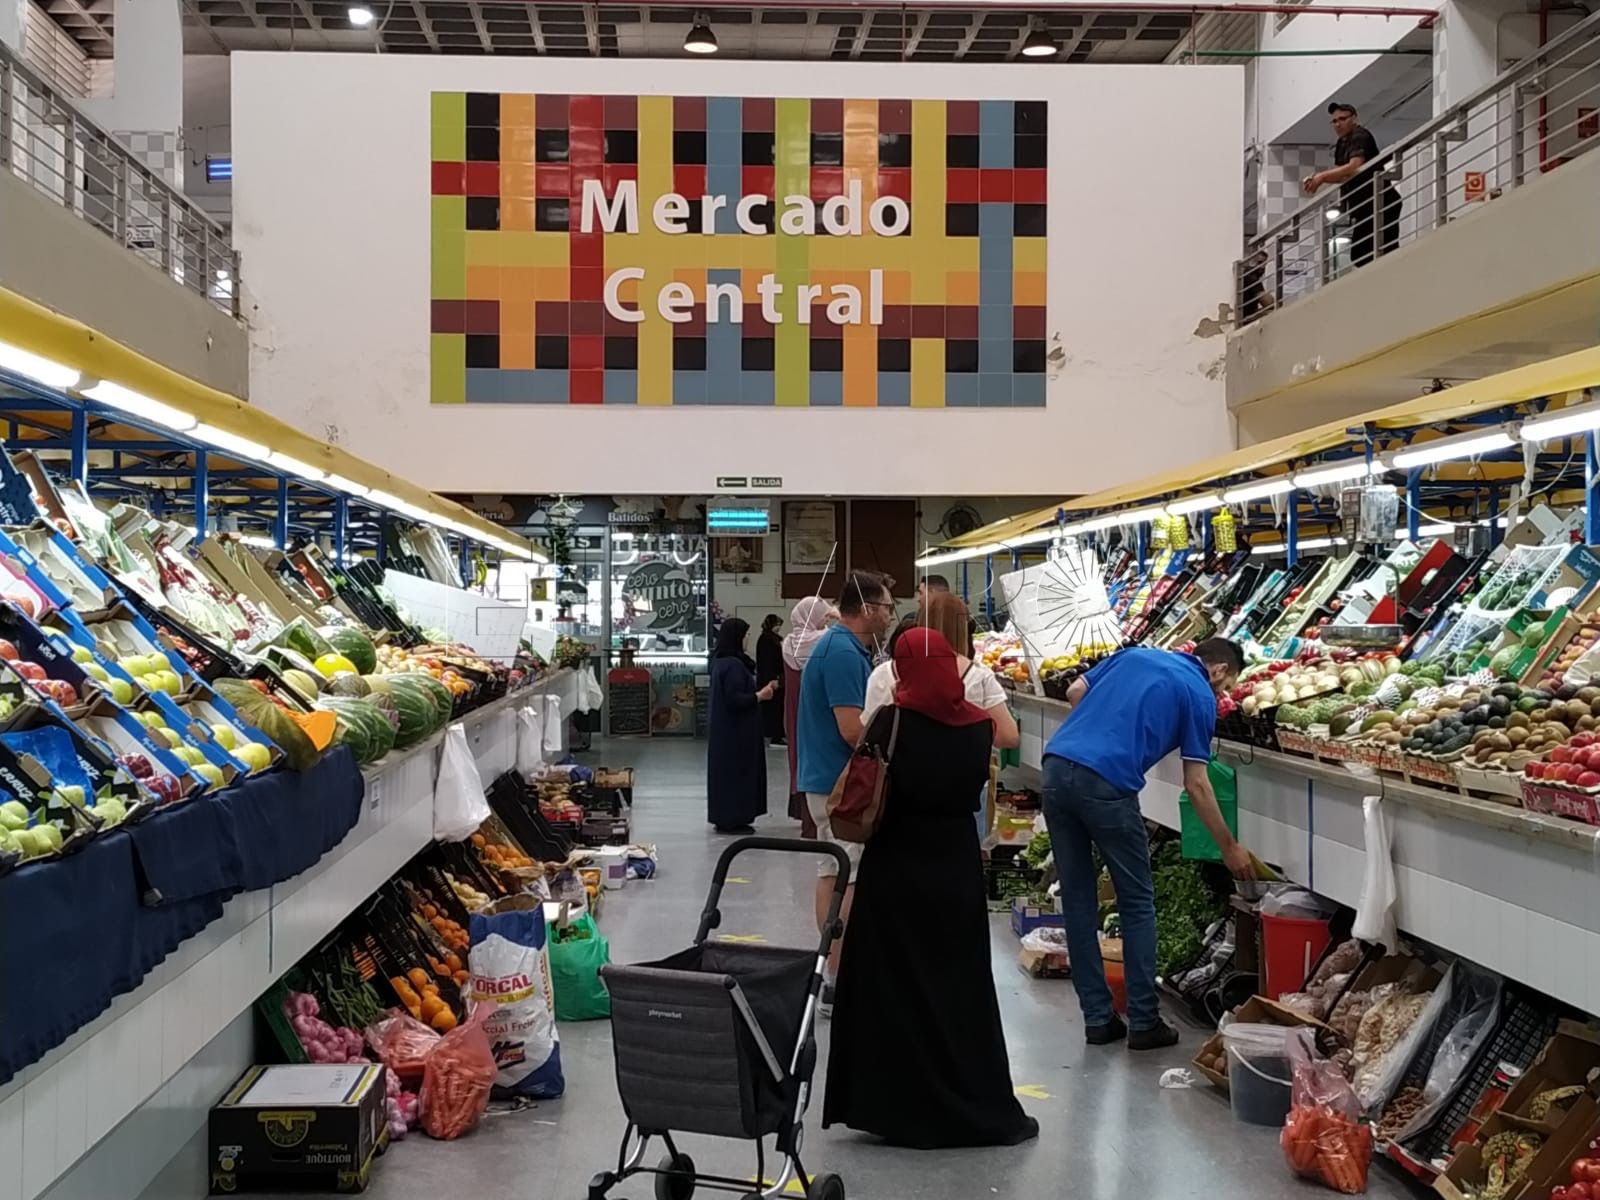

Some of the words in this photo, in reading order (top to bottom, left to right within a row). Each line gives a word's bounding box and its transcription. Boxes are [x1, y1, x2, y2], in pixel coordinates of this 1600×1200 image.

[579, 178, 910, 236] Mercado
[603, 267, 884, 326] Central
[752, 478, 781, 487] SALIDA
[608, 512, 650, 522] Batidos
[626, 573, 657, 588] cero
[629, 581, 690, 601] punto
[659, 601, 690, 618] cero
[472, 975, 533, 995] ORCAL
[305, 1154, 351, 1165] BOUTIQUE
